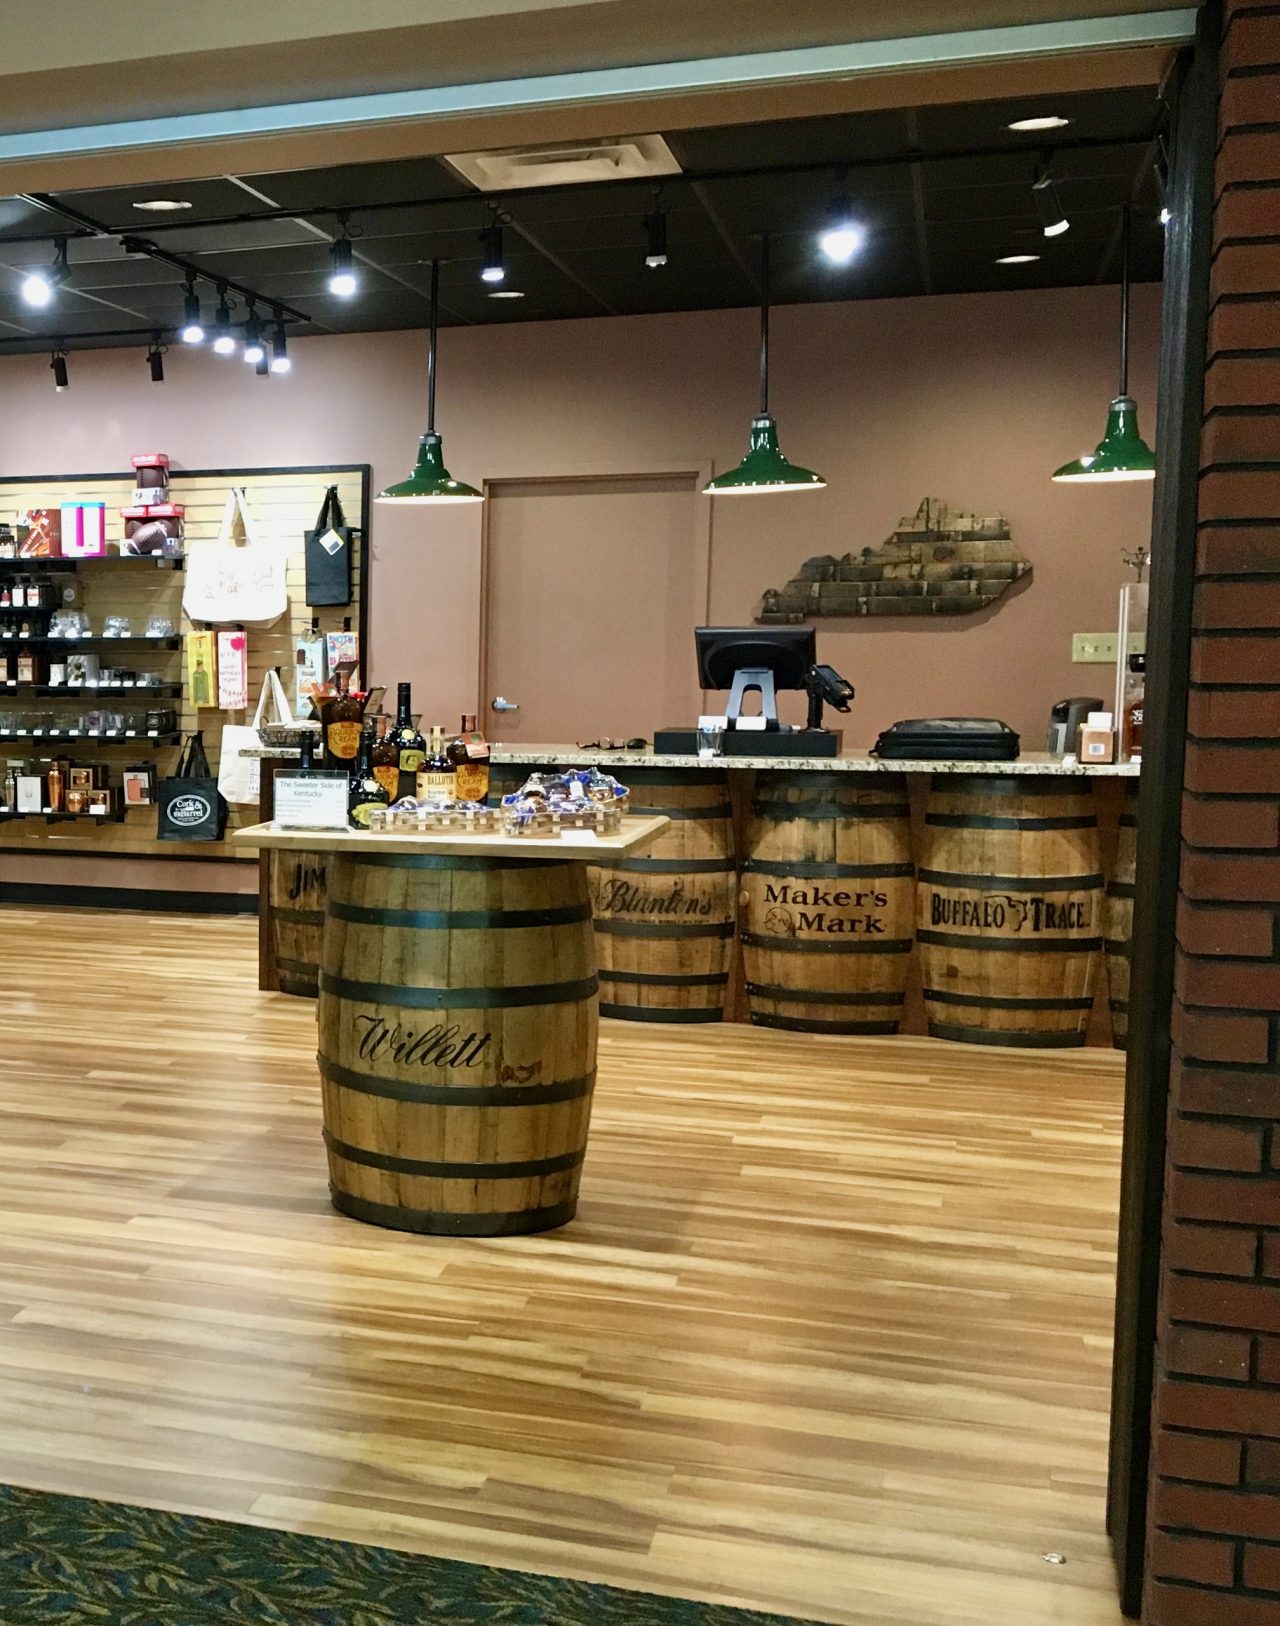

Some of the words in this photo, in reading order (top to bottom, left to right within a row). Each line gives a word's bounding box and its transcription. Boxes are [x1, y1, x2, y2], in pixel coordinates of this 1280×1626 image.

[280, 781, 292, 789] The
[293, 781, 319, 789] Sweeter
[320, 781, 334, 789] Side
[293, 790, 323, 799] Kentucky
[176, 800, 194, 808] Cork
[288, 864, 327, 900] JIM
[763, 883, 888, 908] Maker's
[797, 911, 885, 934] Mark
[931, 893, 1006, 928] BUFFALO
[1030, 897, 1085, 932] TRACE
[355, 1014, 492, 1069] Willett
